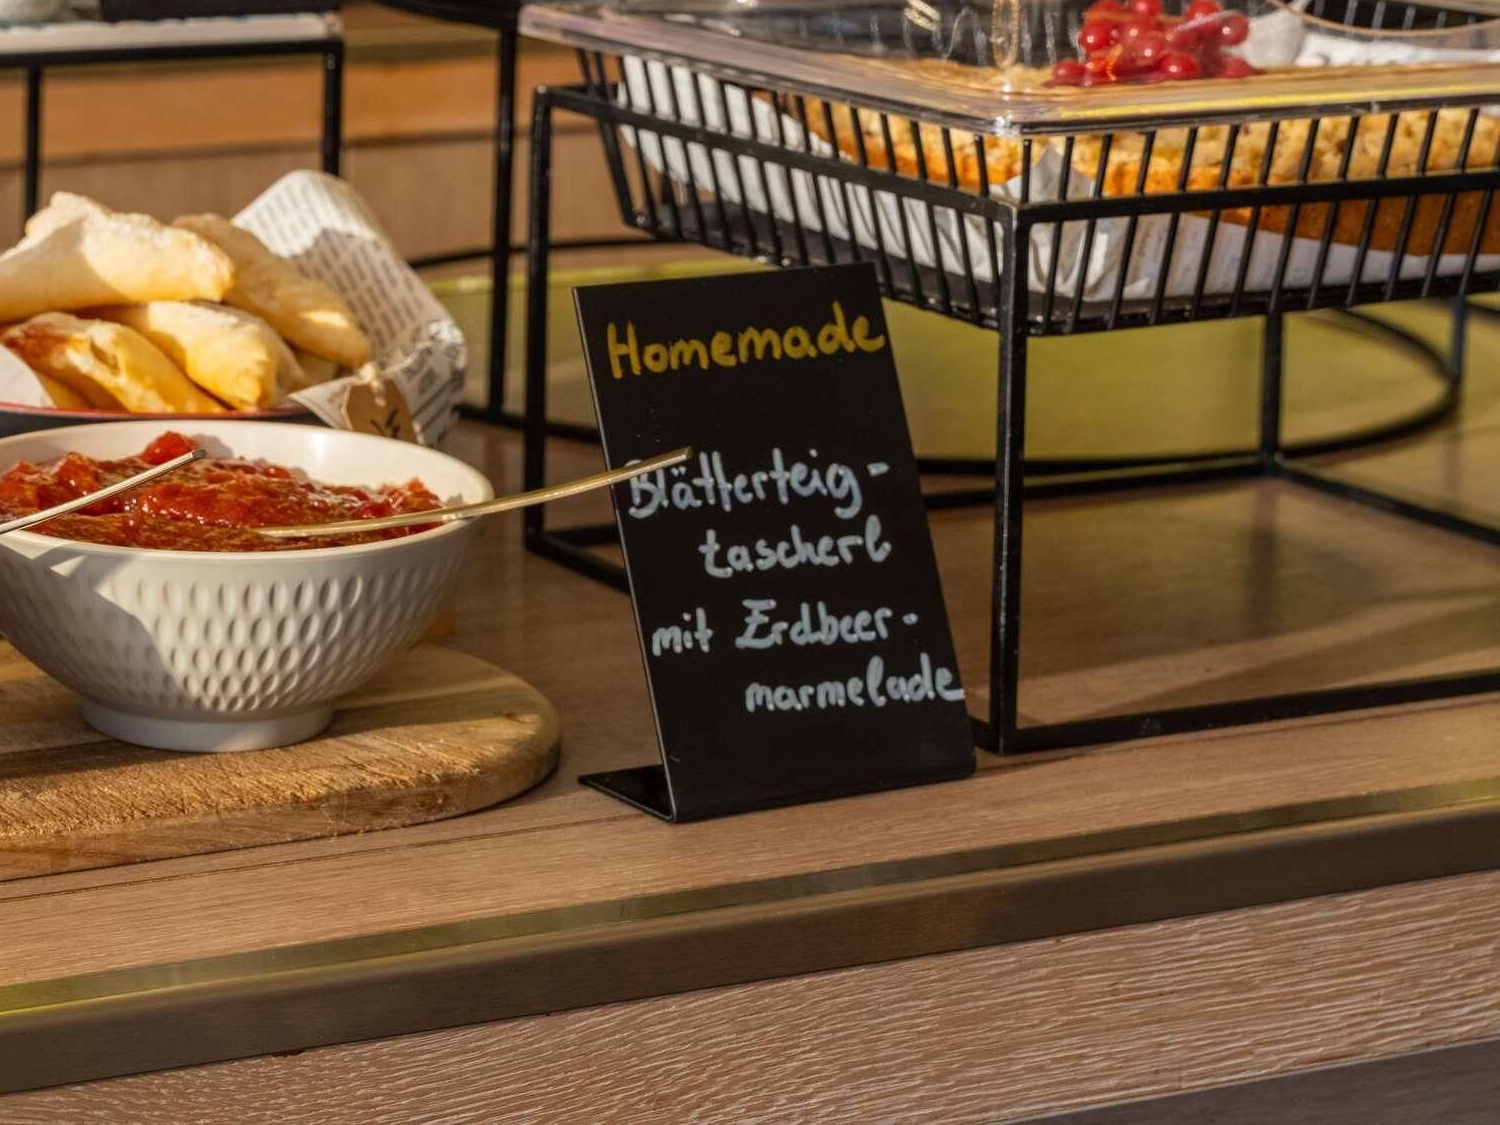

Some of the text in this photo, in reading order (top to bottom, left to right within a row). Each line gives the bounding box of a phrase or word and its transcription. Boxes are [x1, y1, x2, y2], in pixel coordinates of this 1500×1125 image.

[606, 301, 886, 379] Homemade
[698, 514, 891, 578] tascherl
[651, 599, 919, 657] mit Erdbeer-
[744, 653, 966, 713] marmelade
